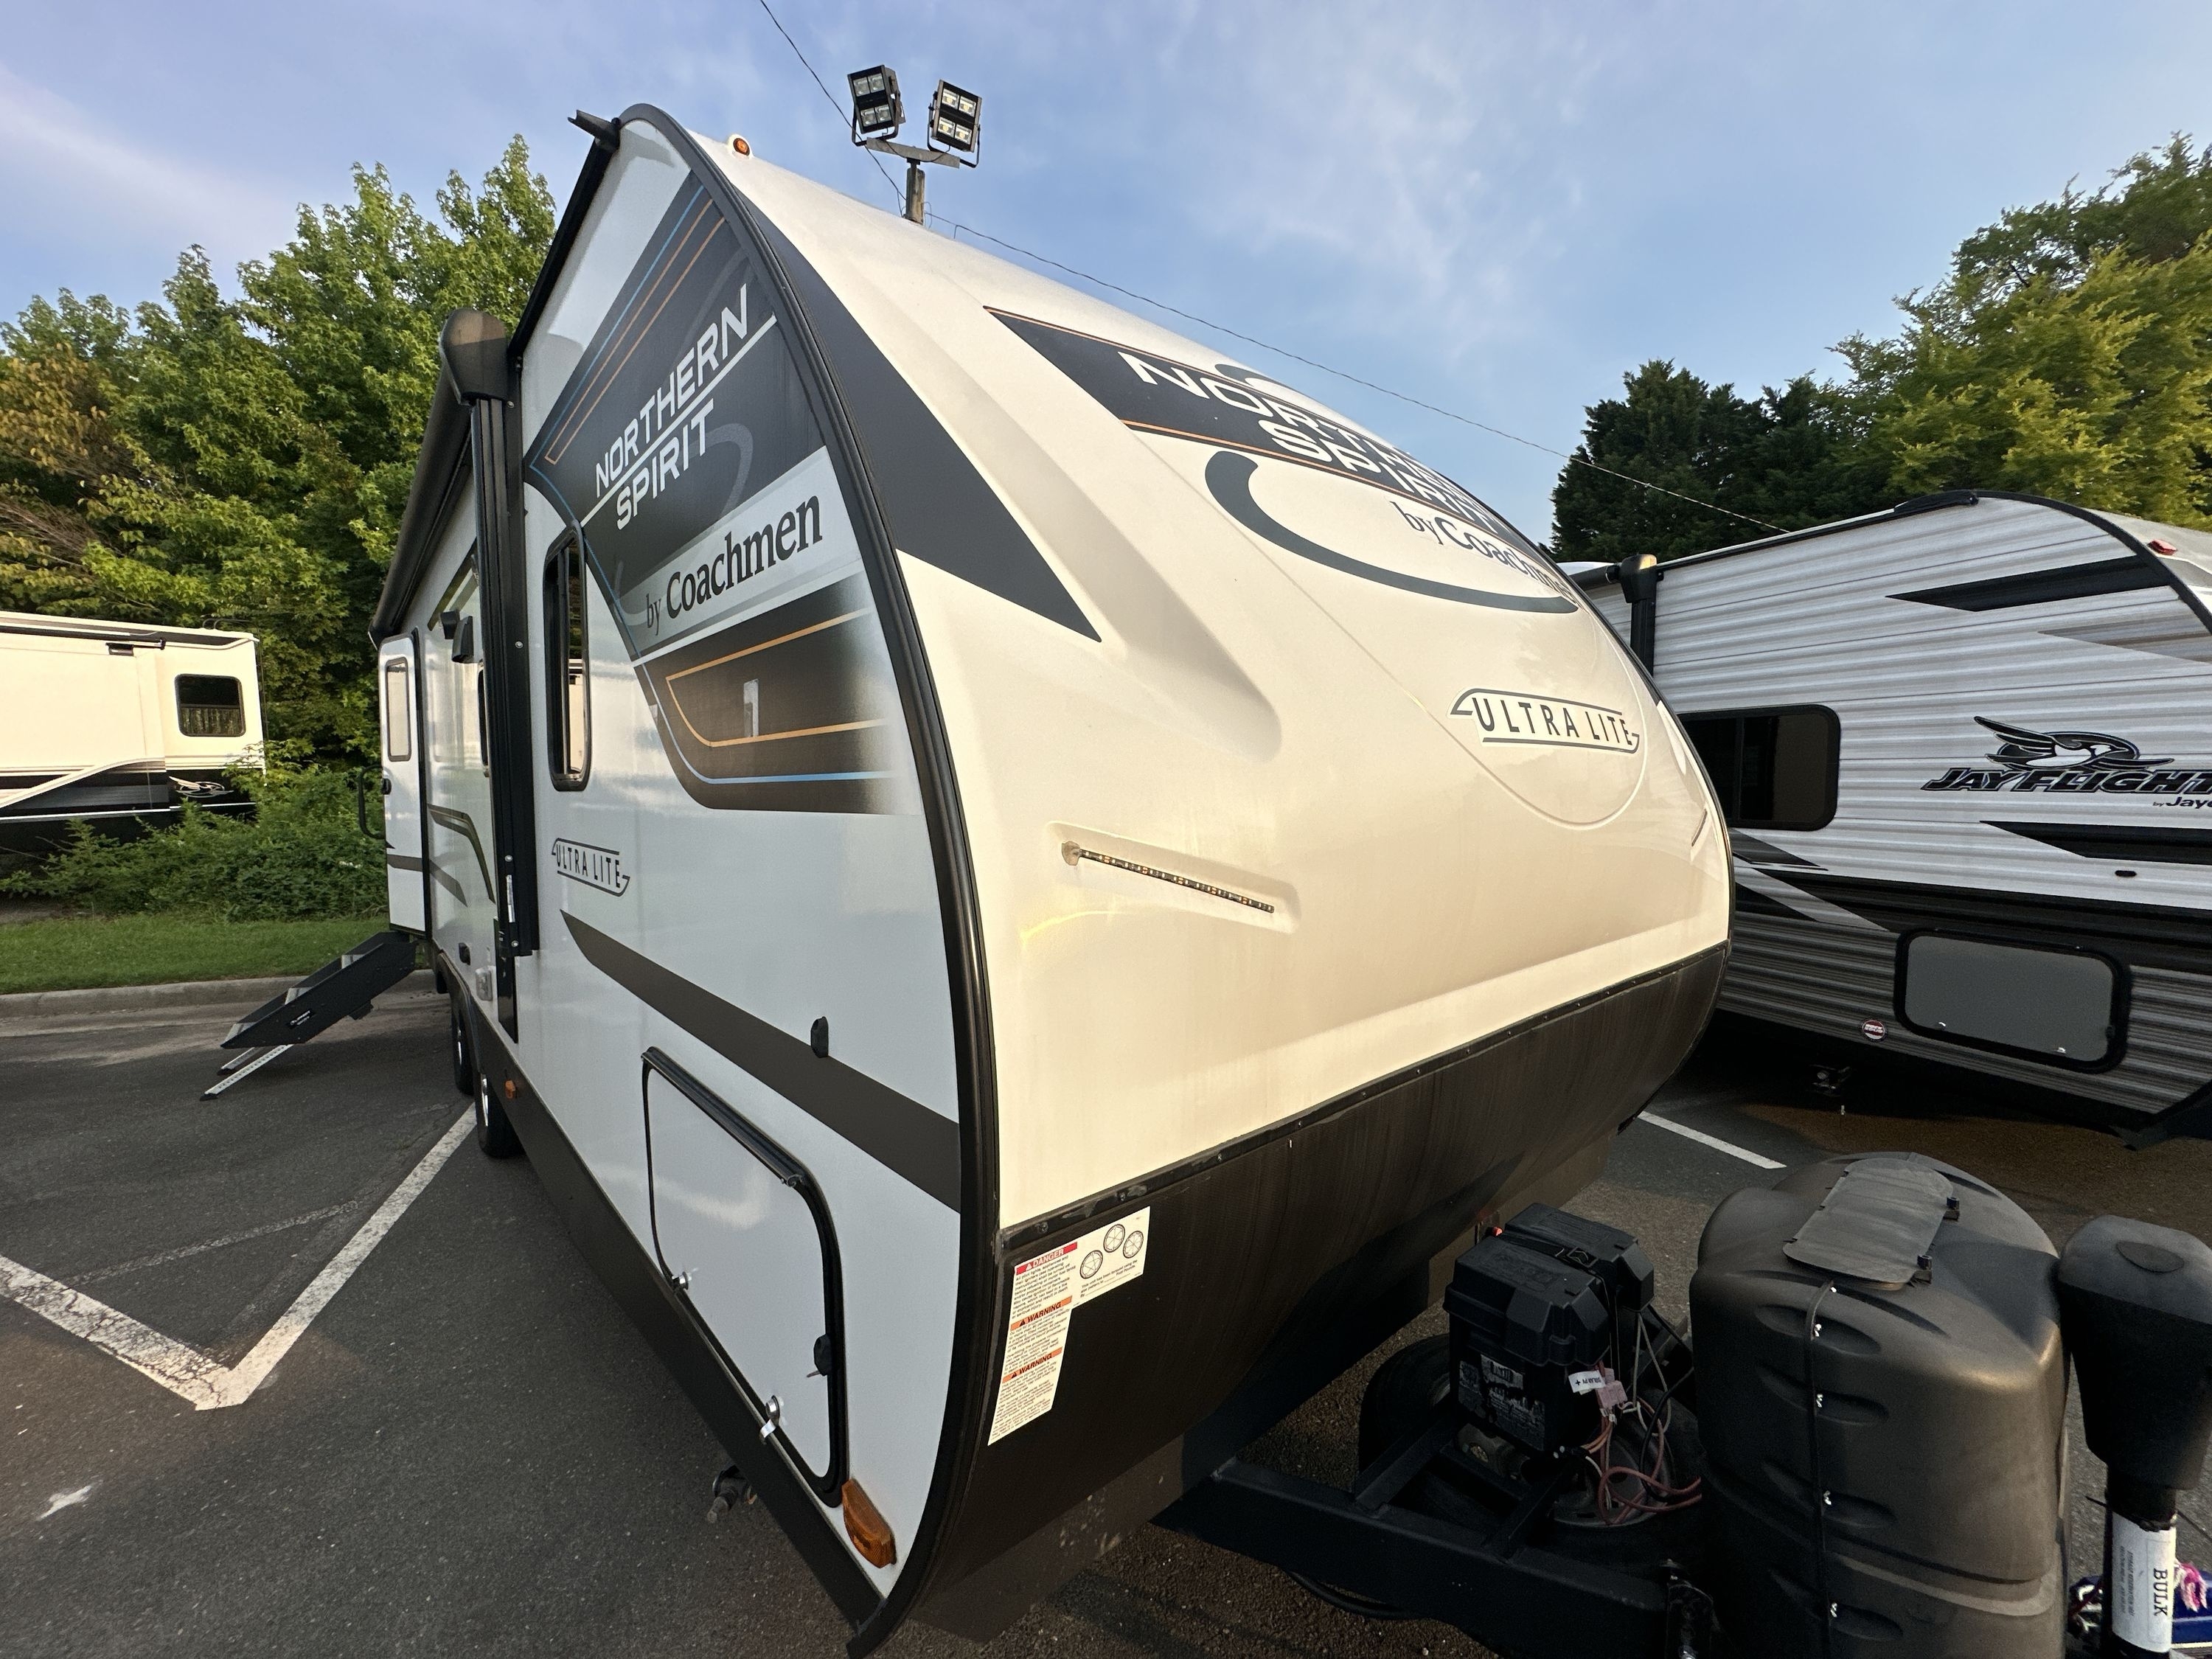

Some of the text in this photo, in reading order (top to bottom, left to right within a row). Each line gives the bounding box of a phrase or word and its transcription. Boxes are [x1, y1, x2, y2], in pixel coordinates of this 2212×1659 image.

[595, 283, 748, 498] NORTHERN
[616, 398, 714, 531] SPIRIT
[1258, 420, 1498, 534] SPIRIT
[1390, 501, 1444, 546] by
[646, 495, 823, 636] by Coachmen
[1472, 698, 1632, 745] ULTRA LITE
[1921, 768, 2212, 795] JAY FLIGHT
[556, 844, 620, 888] ULTRA LITE
[1033, 1249, 1064, 1267] DANGER
[1028, 1301, 1061, 1323] WARNING
[1019, 1353, 1052, 1374] WARNING
[2153, 1568, 2168, 1616] BULK
